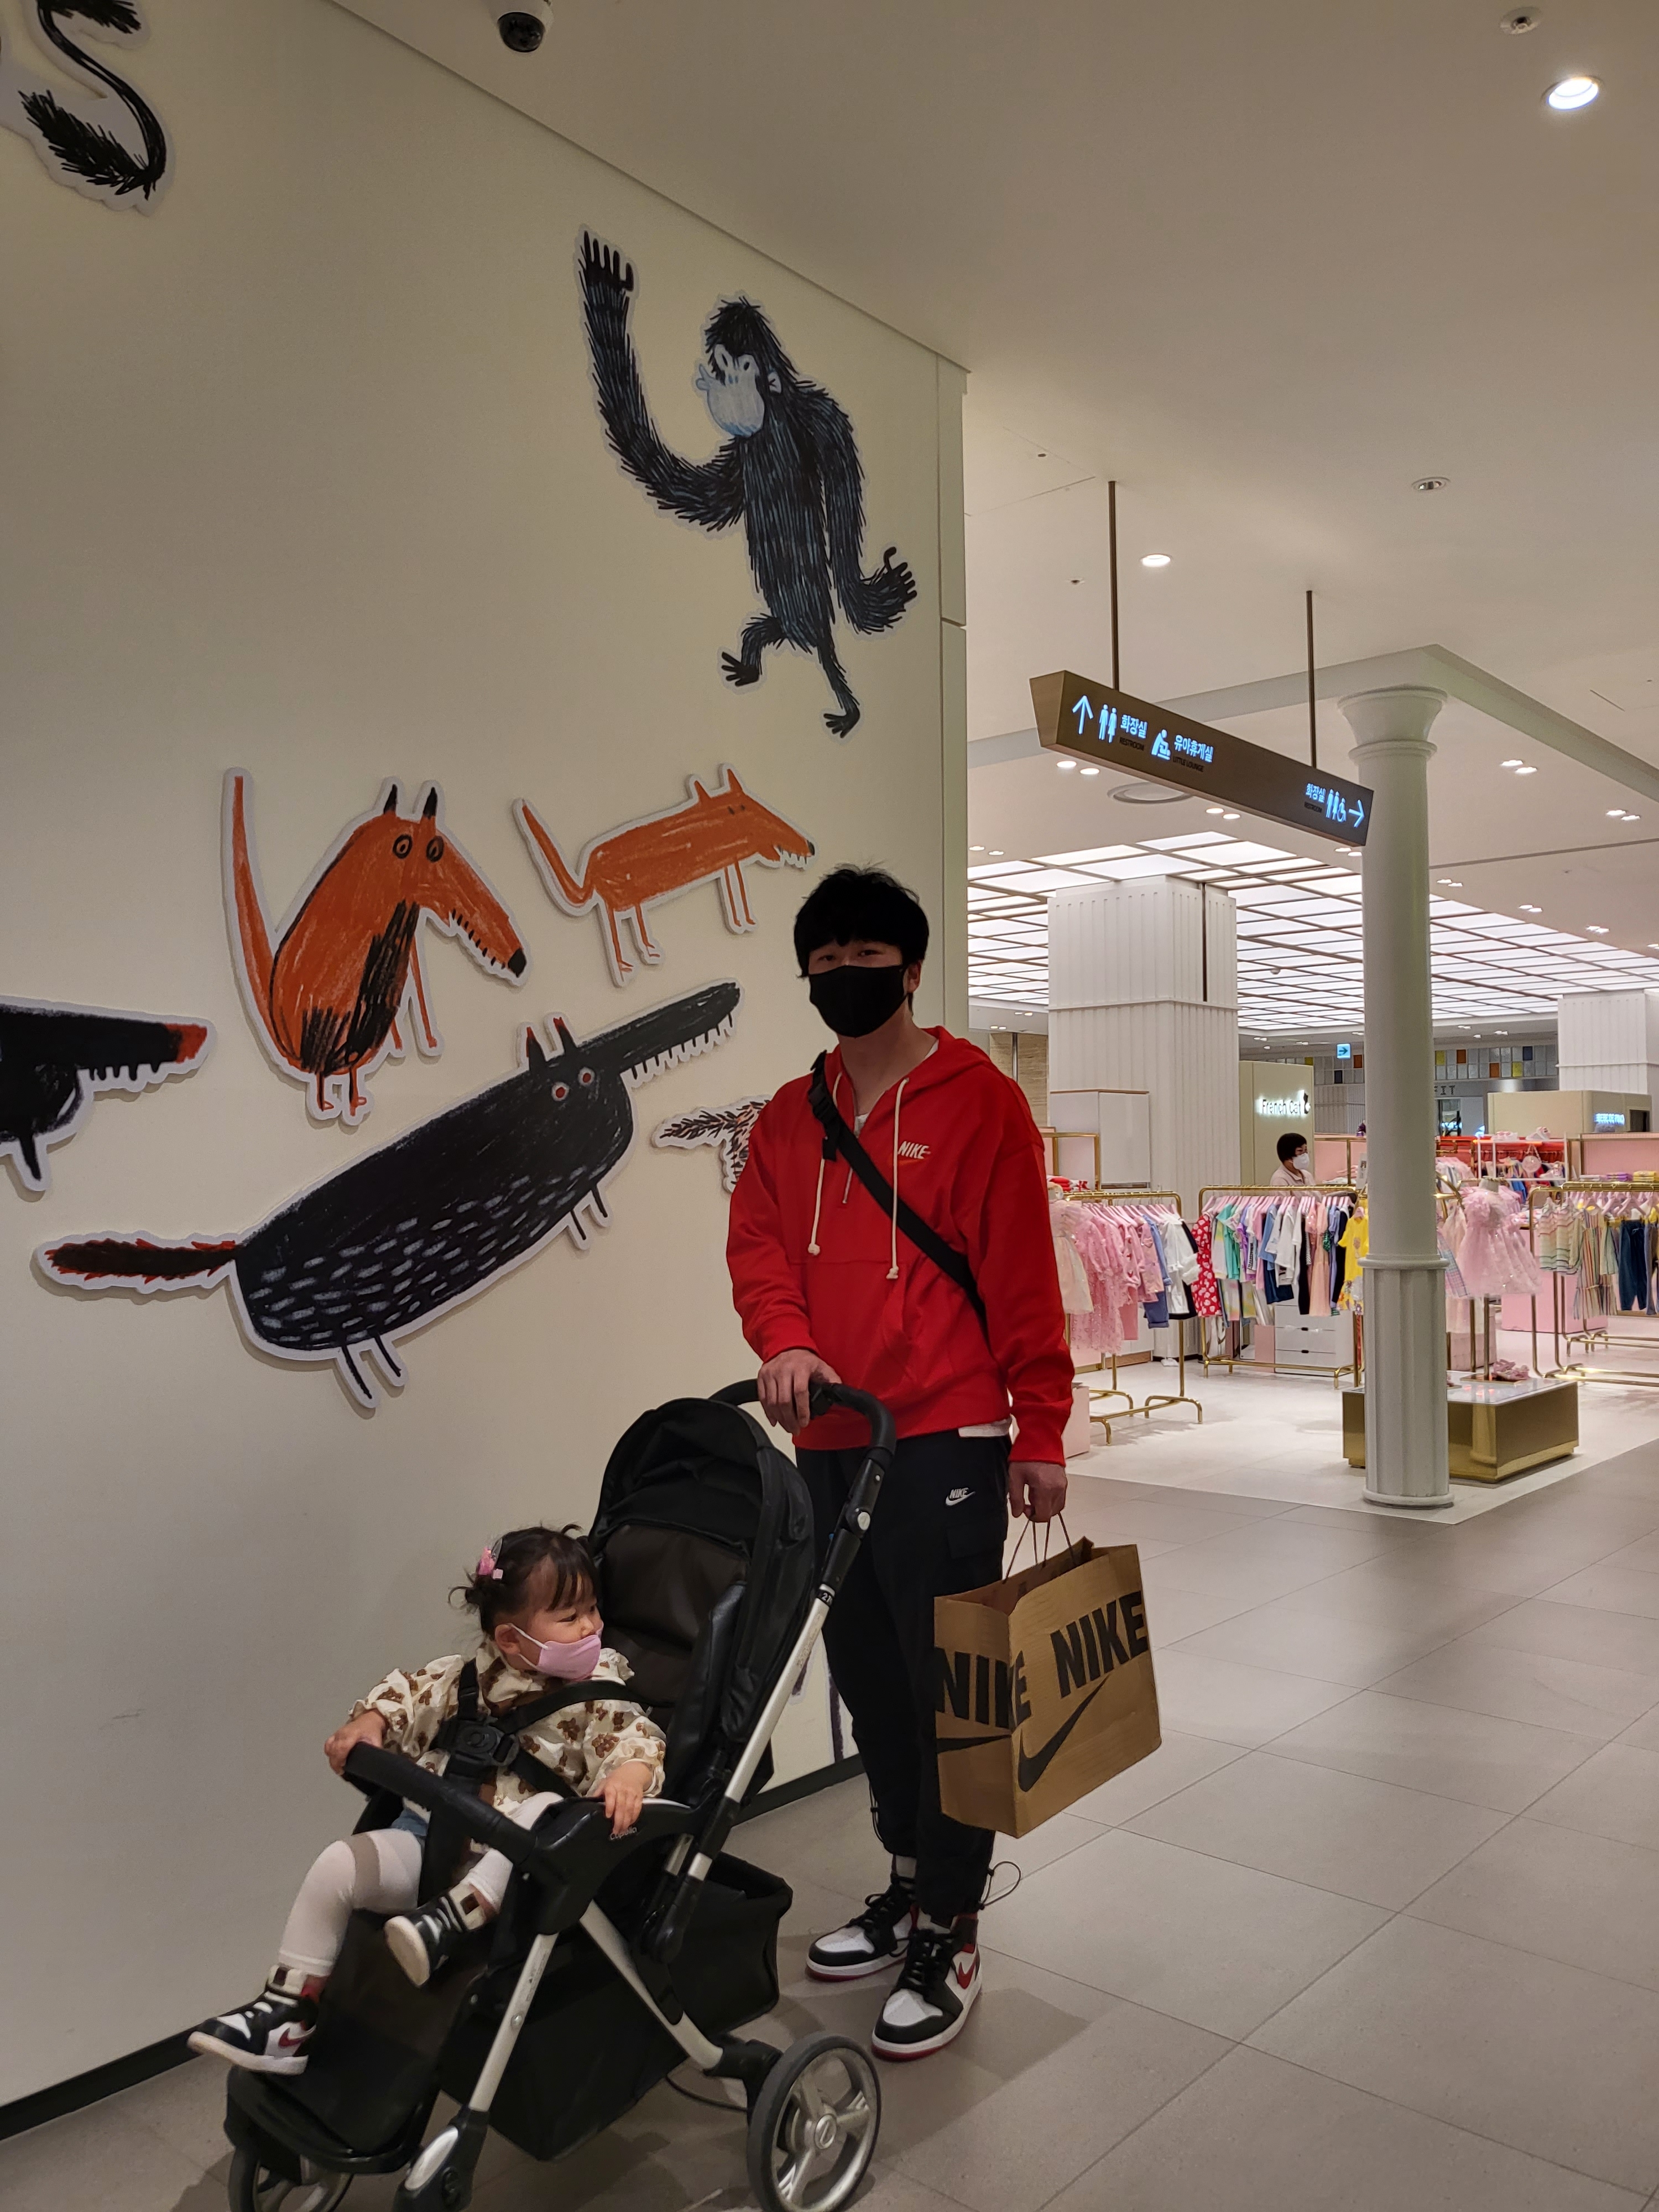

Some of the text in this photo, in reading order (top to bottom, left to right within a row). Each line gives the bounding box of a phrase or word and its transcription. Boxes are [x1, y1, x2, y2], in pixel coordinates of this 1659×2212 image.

[1120, 714, 1148, 739] 화장실
[1119, 737, 1144, 752] RESTROOM
[1174, 734, 1214, 763] 유아휴게실
[1173, 756, 1204, 773] LITTLE LOUNGE
[1306, 783, 1326, 804] 화장실
[1260, 1097, 1287, 1114] French
[898, 1141, 931, 1159] NIKE
[949, 1487, 969, 1499] NIKE
[1051, 1590, 1149, 1699] NIKE
[935, 1647, 1032, 1729] NIKE
